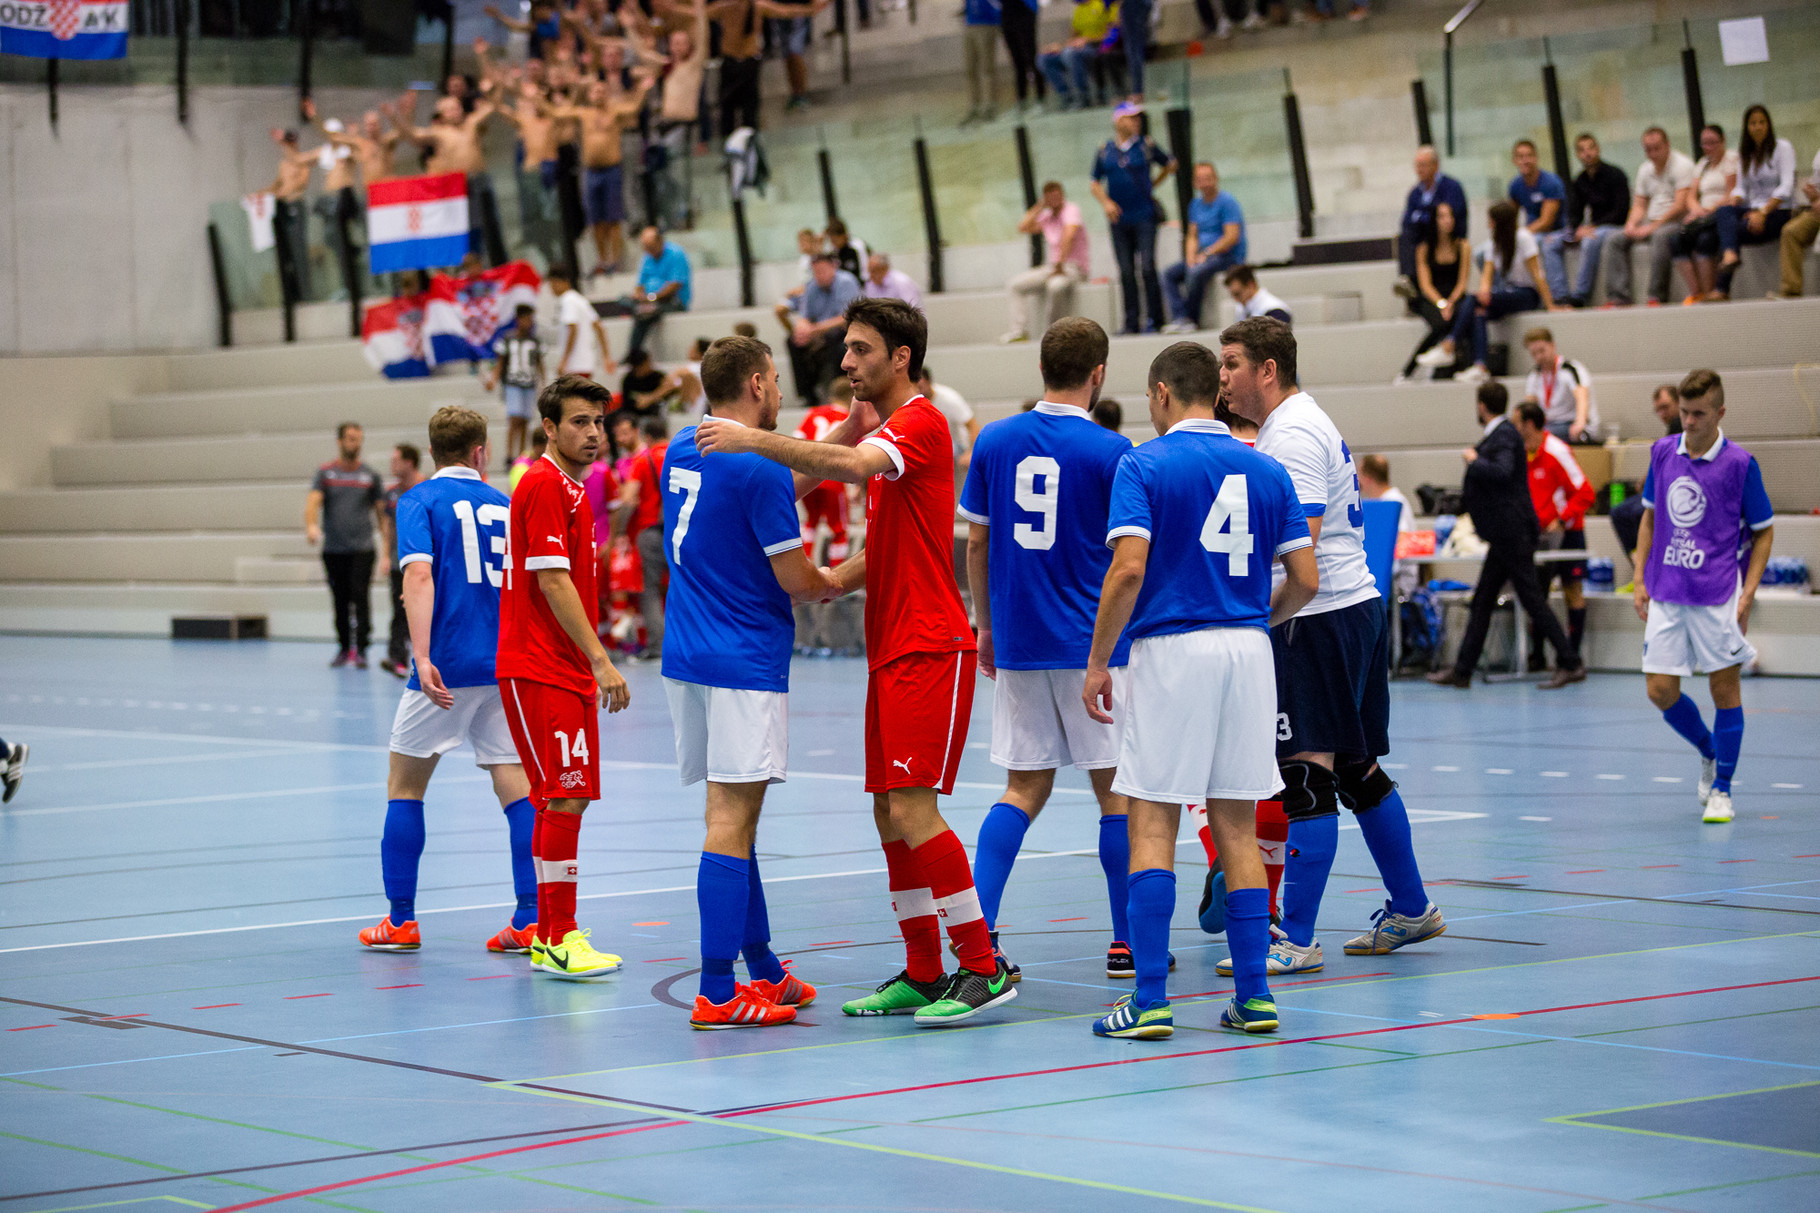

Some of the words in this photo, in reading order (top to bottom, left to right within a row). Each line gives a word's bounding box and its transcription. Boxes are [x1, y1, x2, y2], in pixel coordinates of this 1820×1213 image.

[452, 500, 510, 588] 13
[669, 467, 702, 566] 7
[1014, 456, 1061, 551] 9
[1199, 474, 1254, 577] 4
[1663, 545, 1705, 569] EURO
[554, 728, 589, 767] 14
